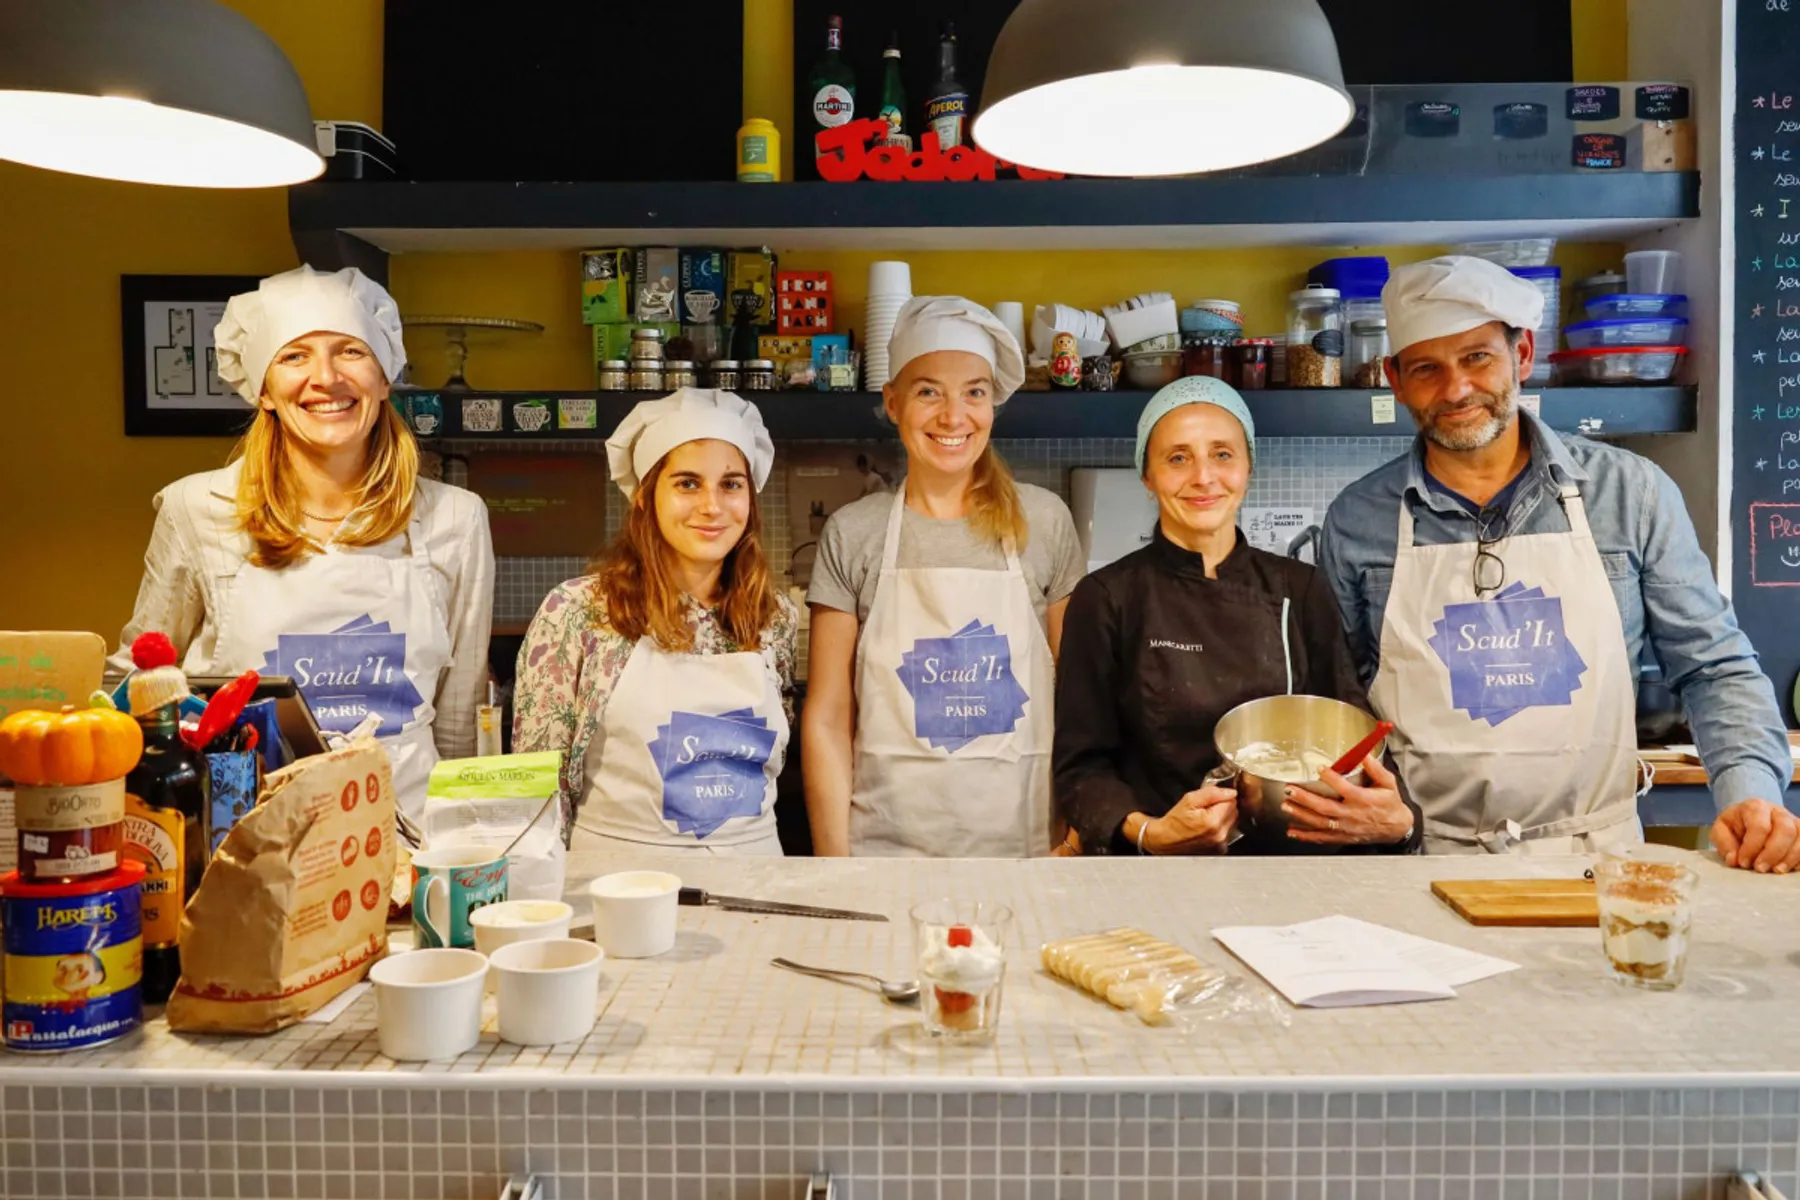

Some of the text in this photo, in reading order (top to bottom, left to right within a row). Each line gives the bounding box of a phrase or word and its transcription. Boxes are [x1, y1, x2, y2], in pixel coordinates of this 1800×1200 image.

[1772, 91, 1793, 109] Le
[929, 100, 965, 119] APEROL
[1771, 144, 1793, 161] Le
[1457, 620, 1555, 652] Scud'It
[294, 656, 394, 688] Scud'It
[922, 655, 1003, 683] Scud'It
[1485, 672, 1535, 687] PARIS
[317, 704, 367, 718] PARIS
[945, 705, 987, 717] PARIS
[695, 785, 735, 798] PARIS
